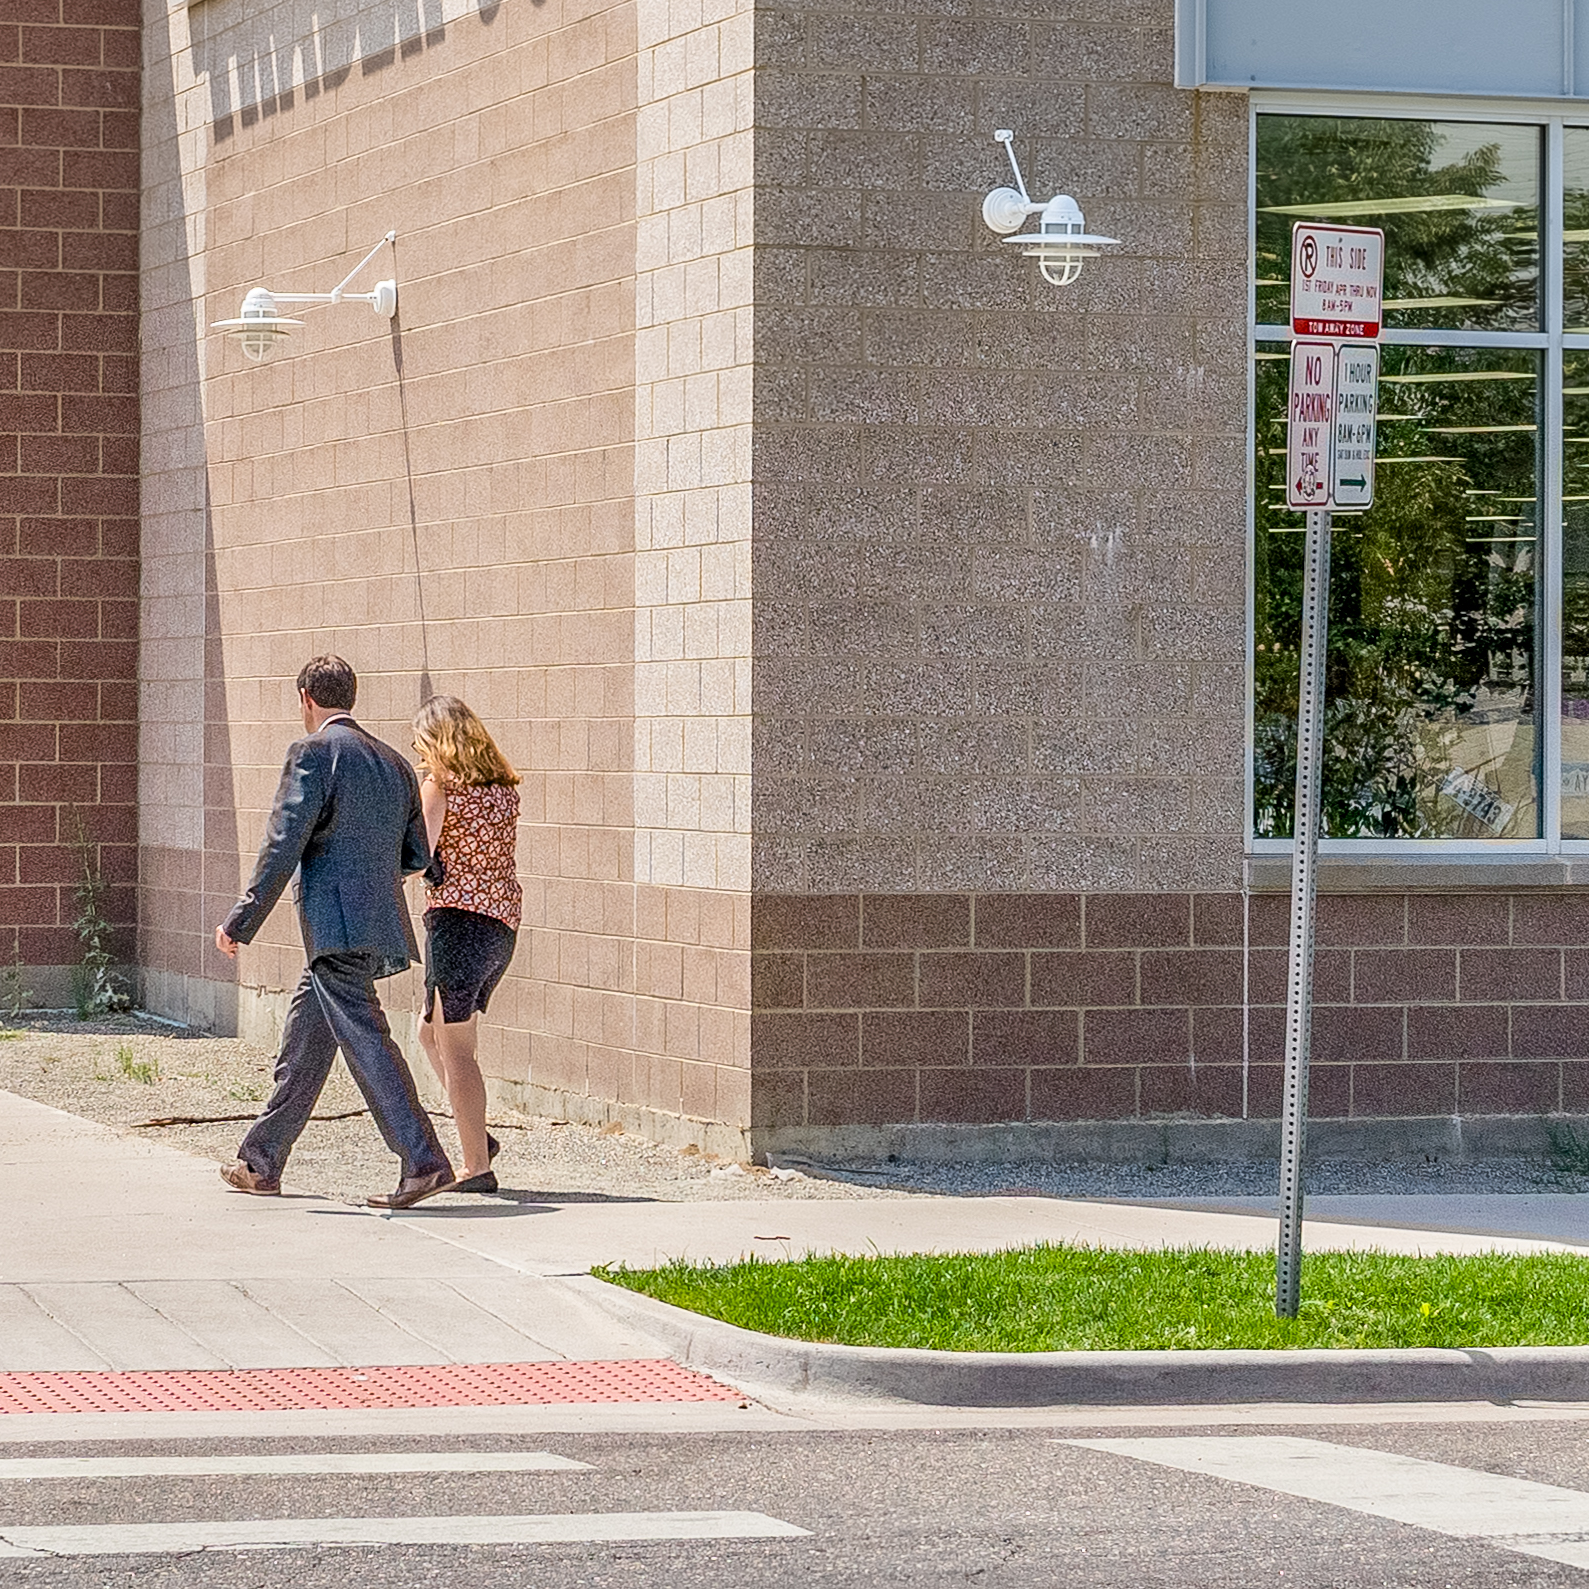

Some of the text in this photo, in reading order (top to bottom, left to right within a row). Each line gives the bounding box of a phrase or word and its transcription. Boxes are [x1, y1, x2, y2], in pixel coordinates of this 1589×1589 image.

[1326, 245, 1367, 270] THIS SIDE
[1315, 280, 1334, 293] FRIDAY
[1335, 283, 1347, 296] APR
[1349, 284, 1364, 297] THRU
[1365, 285, 1377, 298] NOV
[1308, 321, 1365, 336] TOW AWAY ZONE
[1305, 356, 1322, 386] NO
[1349, 363, 1372, 383] HOUR
[1293, 392, 1331, 423] PARKING
[1338, 393, 1373, 414] PARKING
[1301, 427, 1320, 448] ANY
[1301, 452, 1319, 473] TIME
